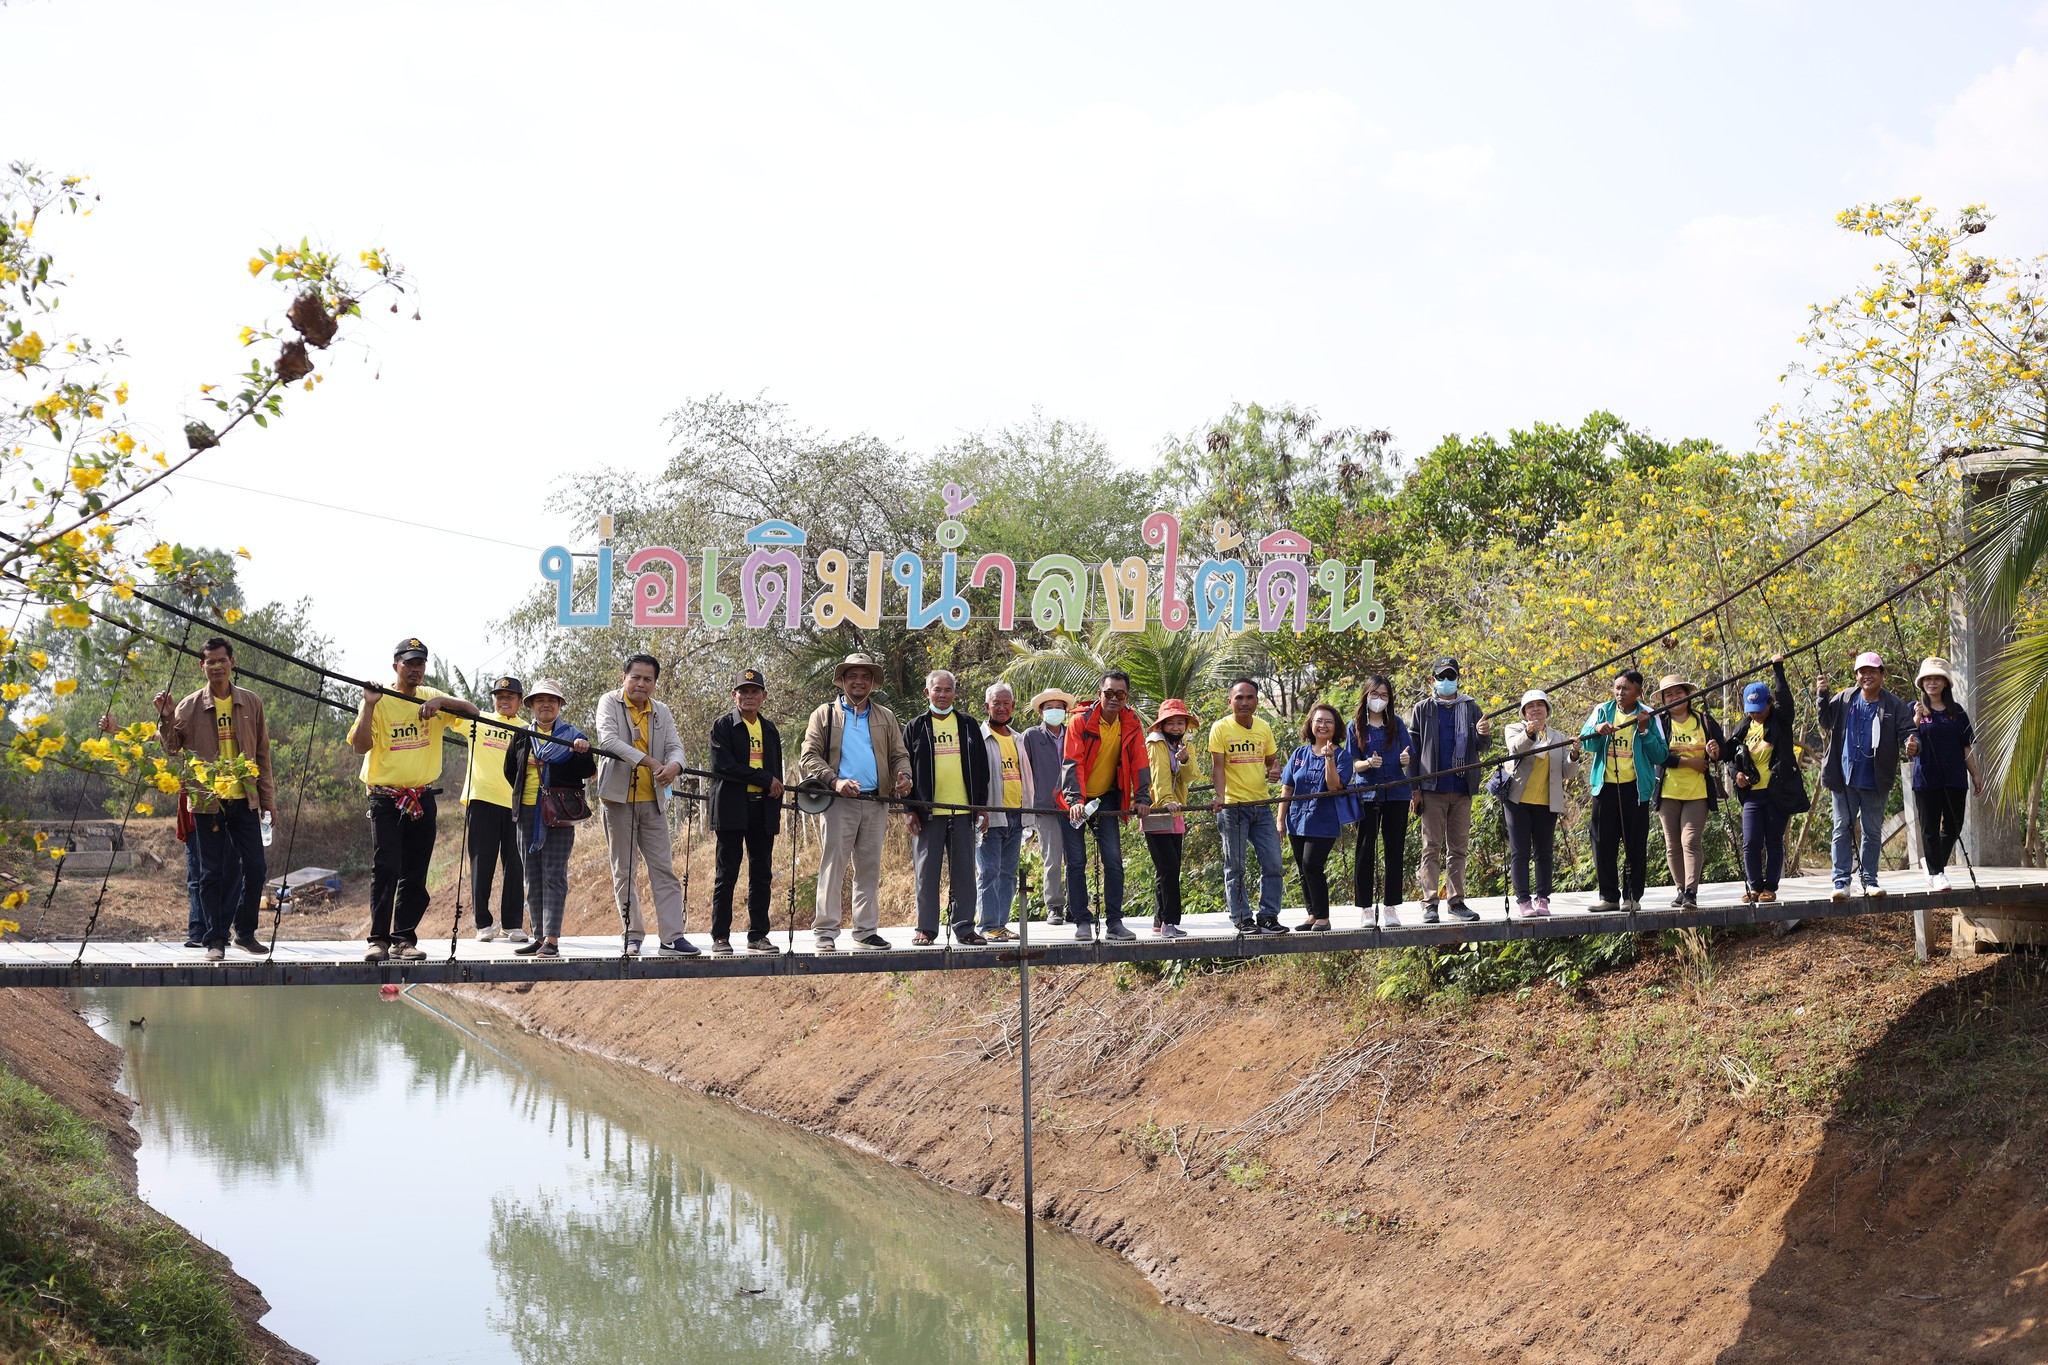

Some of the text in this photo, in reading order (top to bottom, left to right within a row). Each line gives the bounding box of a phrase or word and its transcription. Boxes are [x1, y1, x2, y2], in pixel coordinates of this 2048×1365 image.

[539, 482, 1386, 633] บ่อเติมน้ำลงใต้ดิน
[391, 723, 418, 738] งาดำ
[932, 732, 953, 744] าดำ
[1228, 740, 1255, 752] งาดำ
